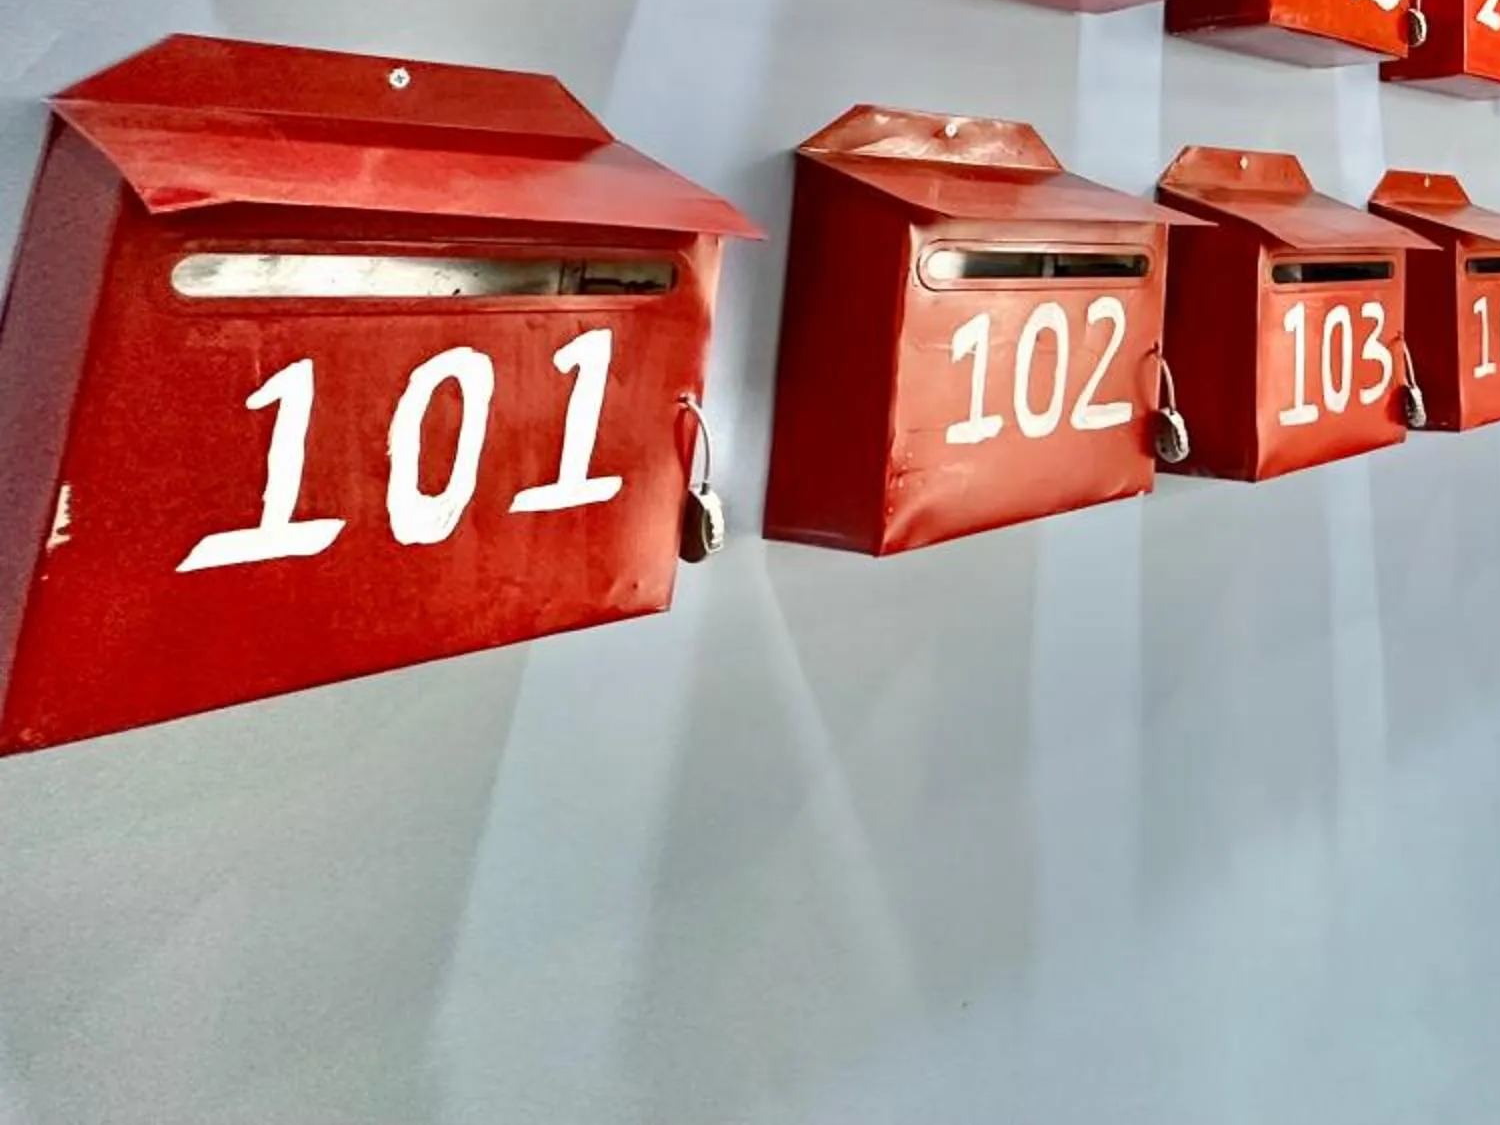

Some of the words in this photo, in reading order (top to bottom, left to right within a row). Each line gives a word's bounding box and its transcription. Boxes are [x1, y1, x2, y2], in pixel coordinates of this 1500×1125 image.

[945, 295, 1134, 444] 102
[1279, 301, 1394, 426] 103
[174, 328, 623, 574] 101
